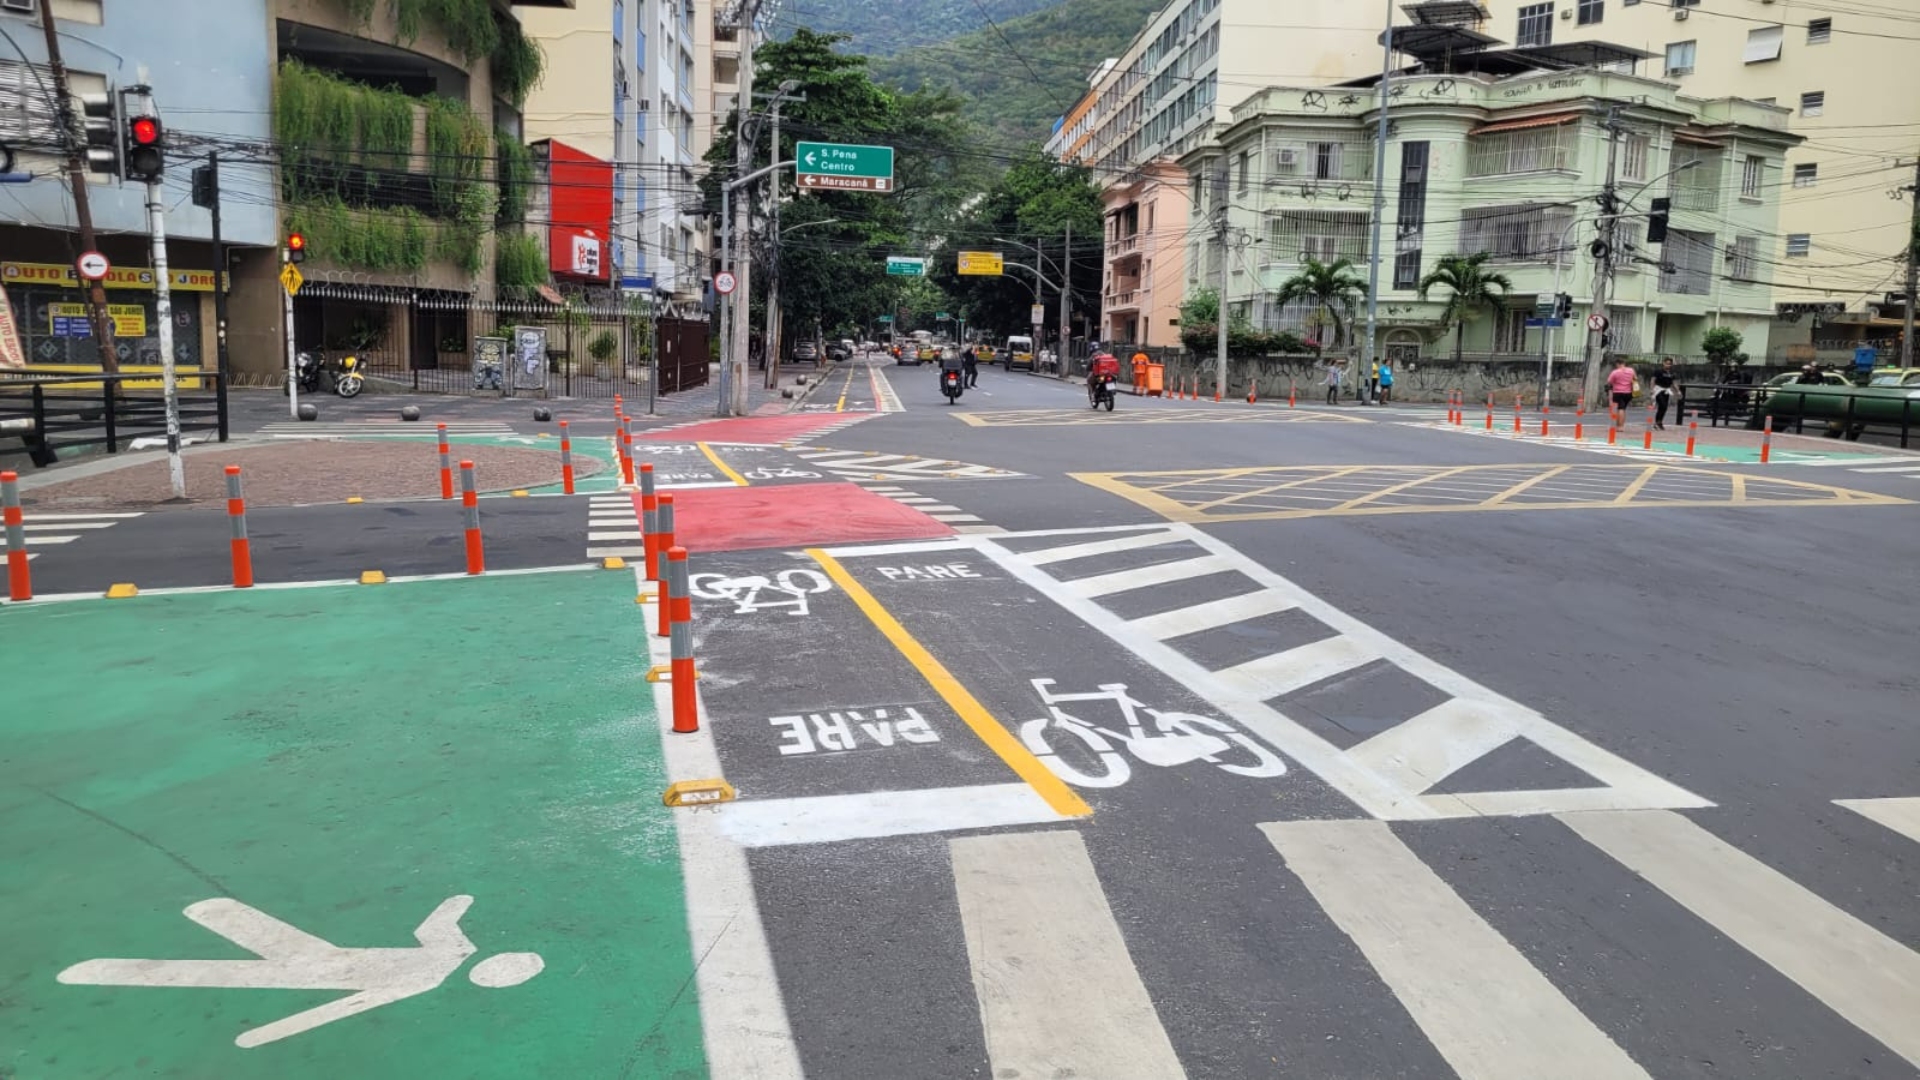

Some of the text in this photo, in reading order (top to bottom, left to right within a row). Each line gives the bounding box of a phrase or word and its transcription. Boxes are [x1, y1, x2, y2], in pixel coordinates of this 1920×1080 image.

[821, 149, 830, 157] S.
[821, 161, 855, 171] Centro
[820, 176, 868, 187] Maracanã
[876, 564, 982, 580] PARE
[768, 707, 941, 755] PARE
